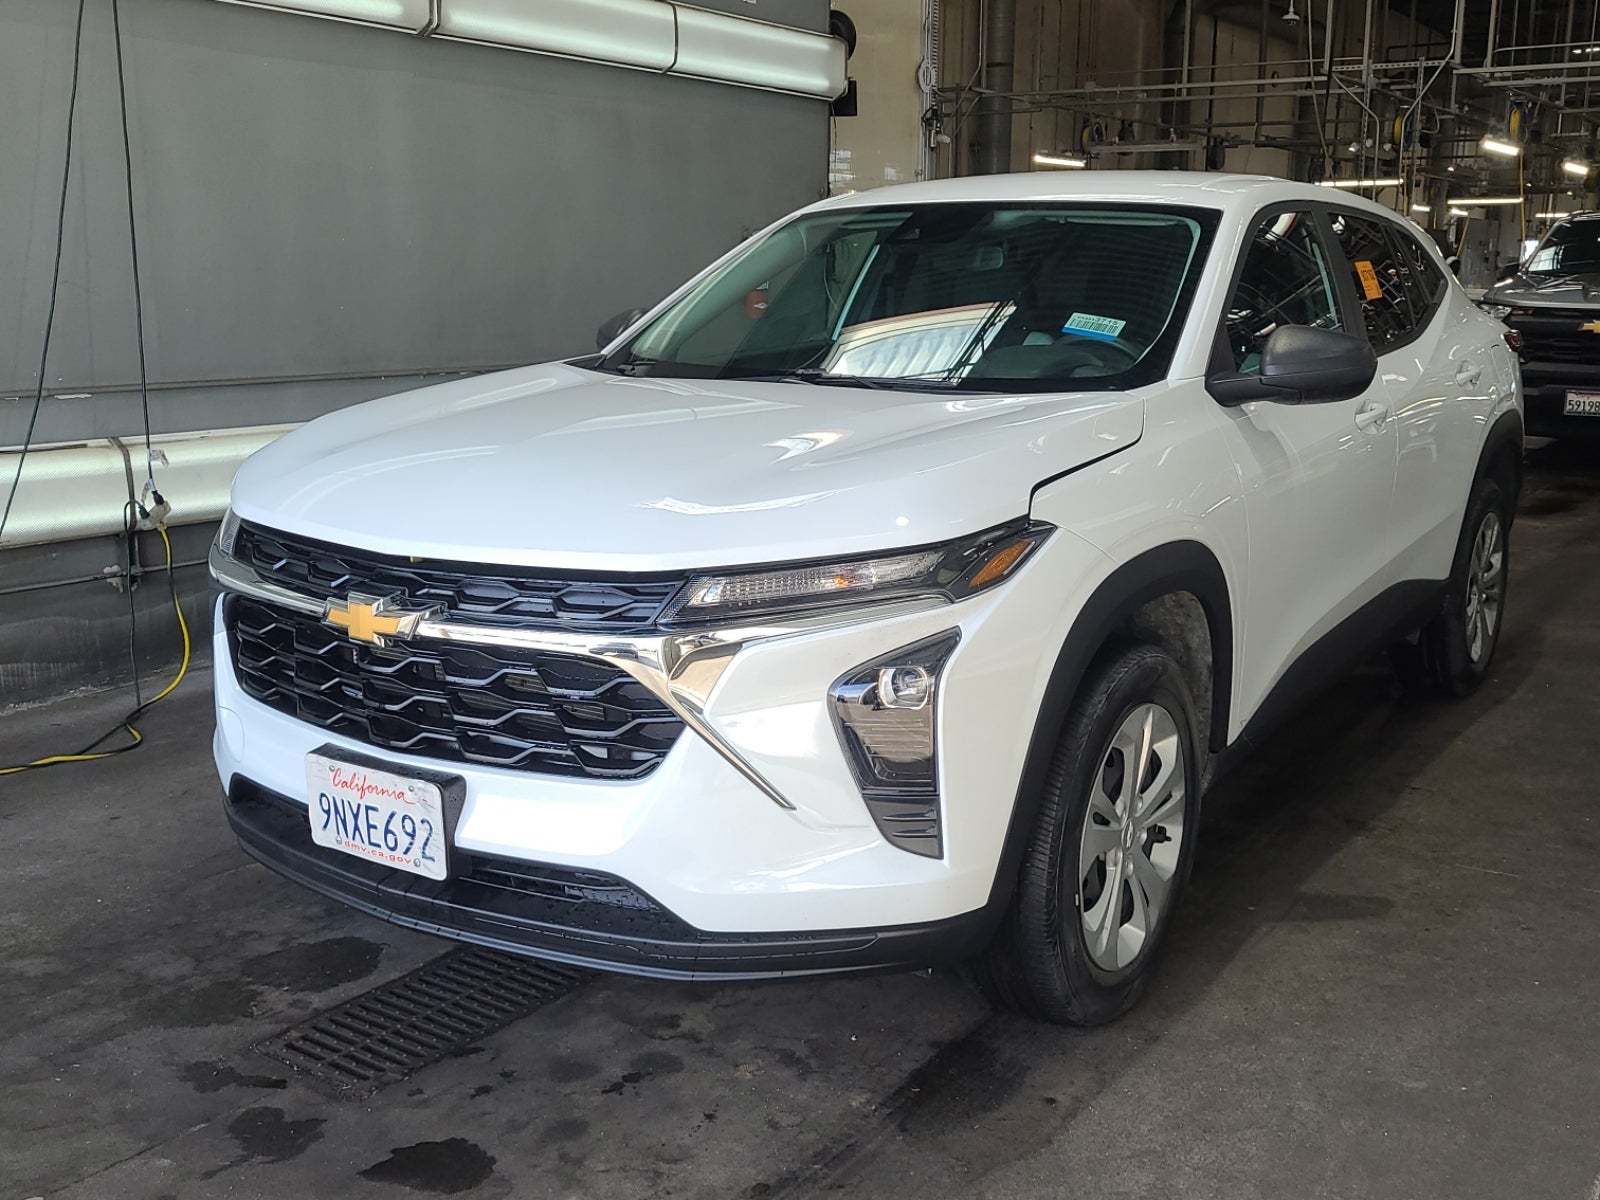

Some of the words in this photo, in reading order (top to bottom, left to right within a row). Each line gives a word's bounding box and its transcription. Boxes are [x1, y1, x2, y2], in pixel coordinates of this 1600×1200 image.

[332, 767, 416, 805] California
[319, 792, 436, 863] 9NXE692
[344, 841, 412, 865] dmv.ca.gov
